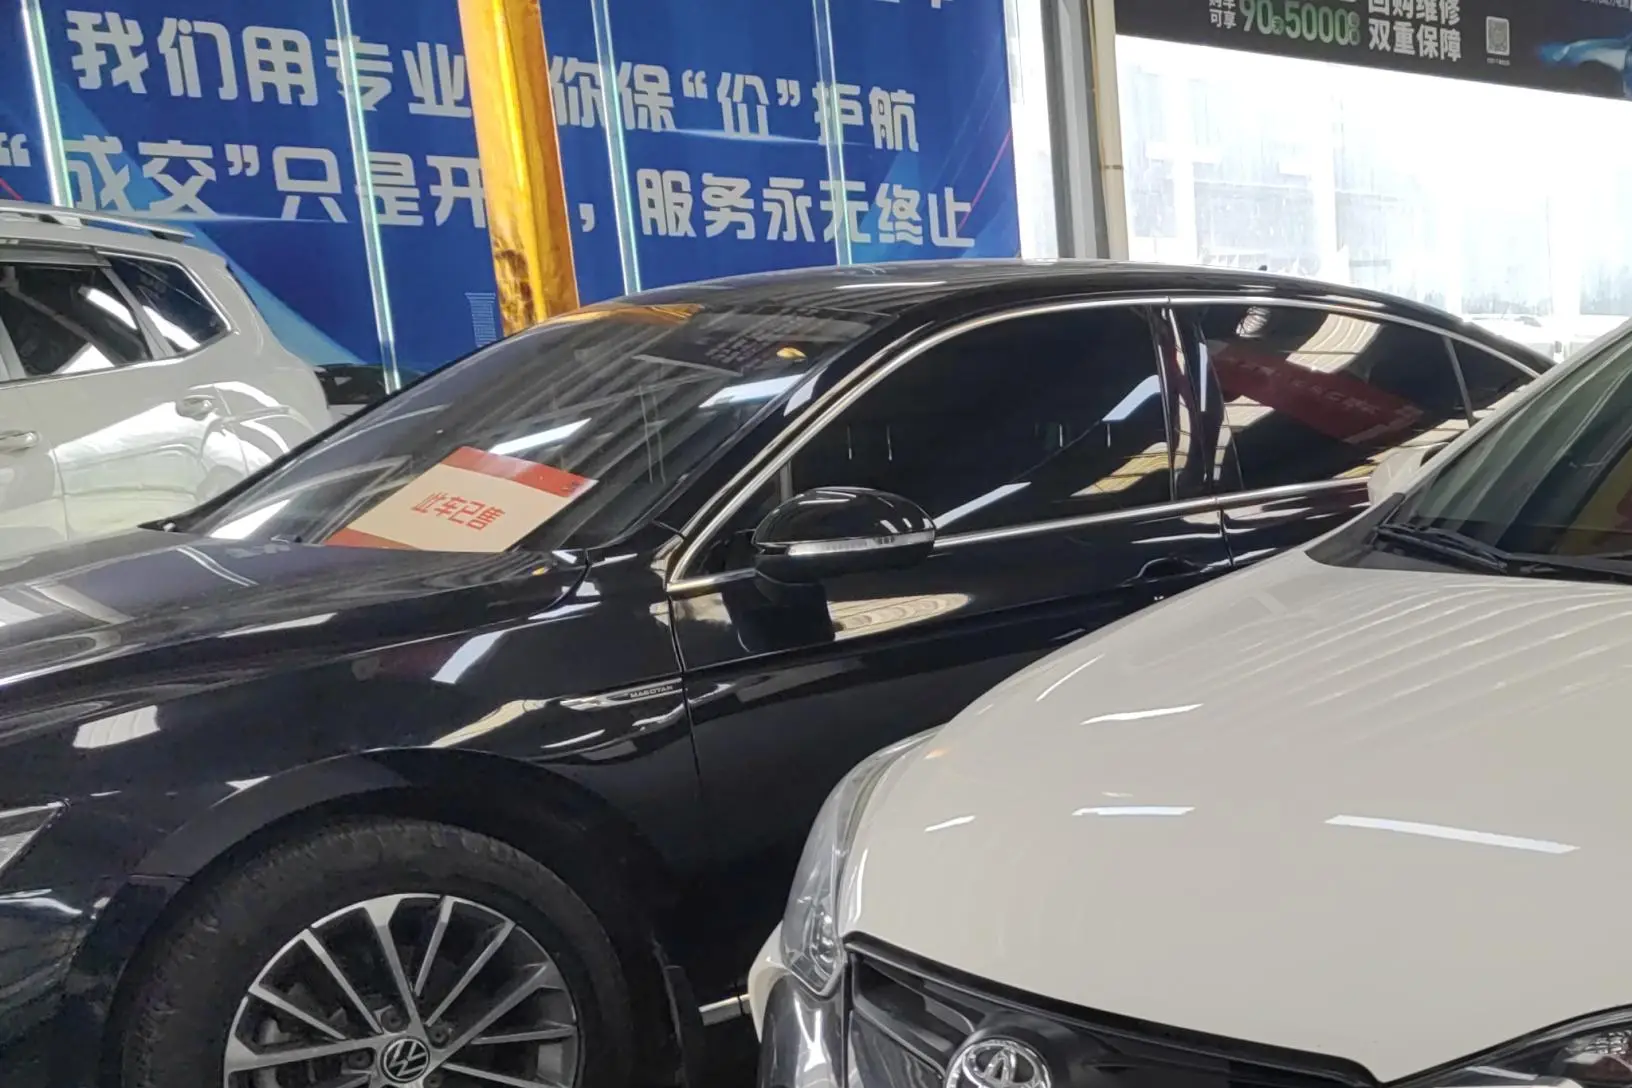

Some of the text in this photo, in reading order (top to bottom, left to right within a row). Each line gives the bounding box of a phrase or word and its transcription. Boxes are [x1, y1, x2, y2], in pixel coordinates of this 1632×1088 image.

[1368, 18, 1462, 62] 双重保障
[66, 10, 919, 152] 我们用专业你保“价”护航
[0, 132, 976, 247] “成交”只是开，服务永无终止
[411, 492, 505, 530] 此车已售
